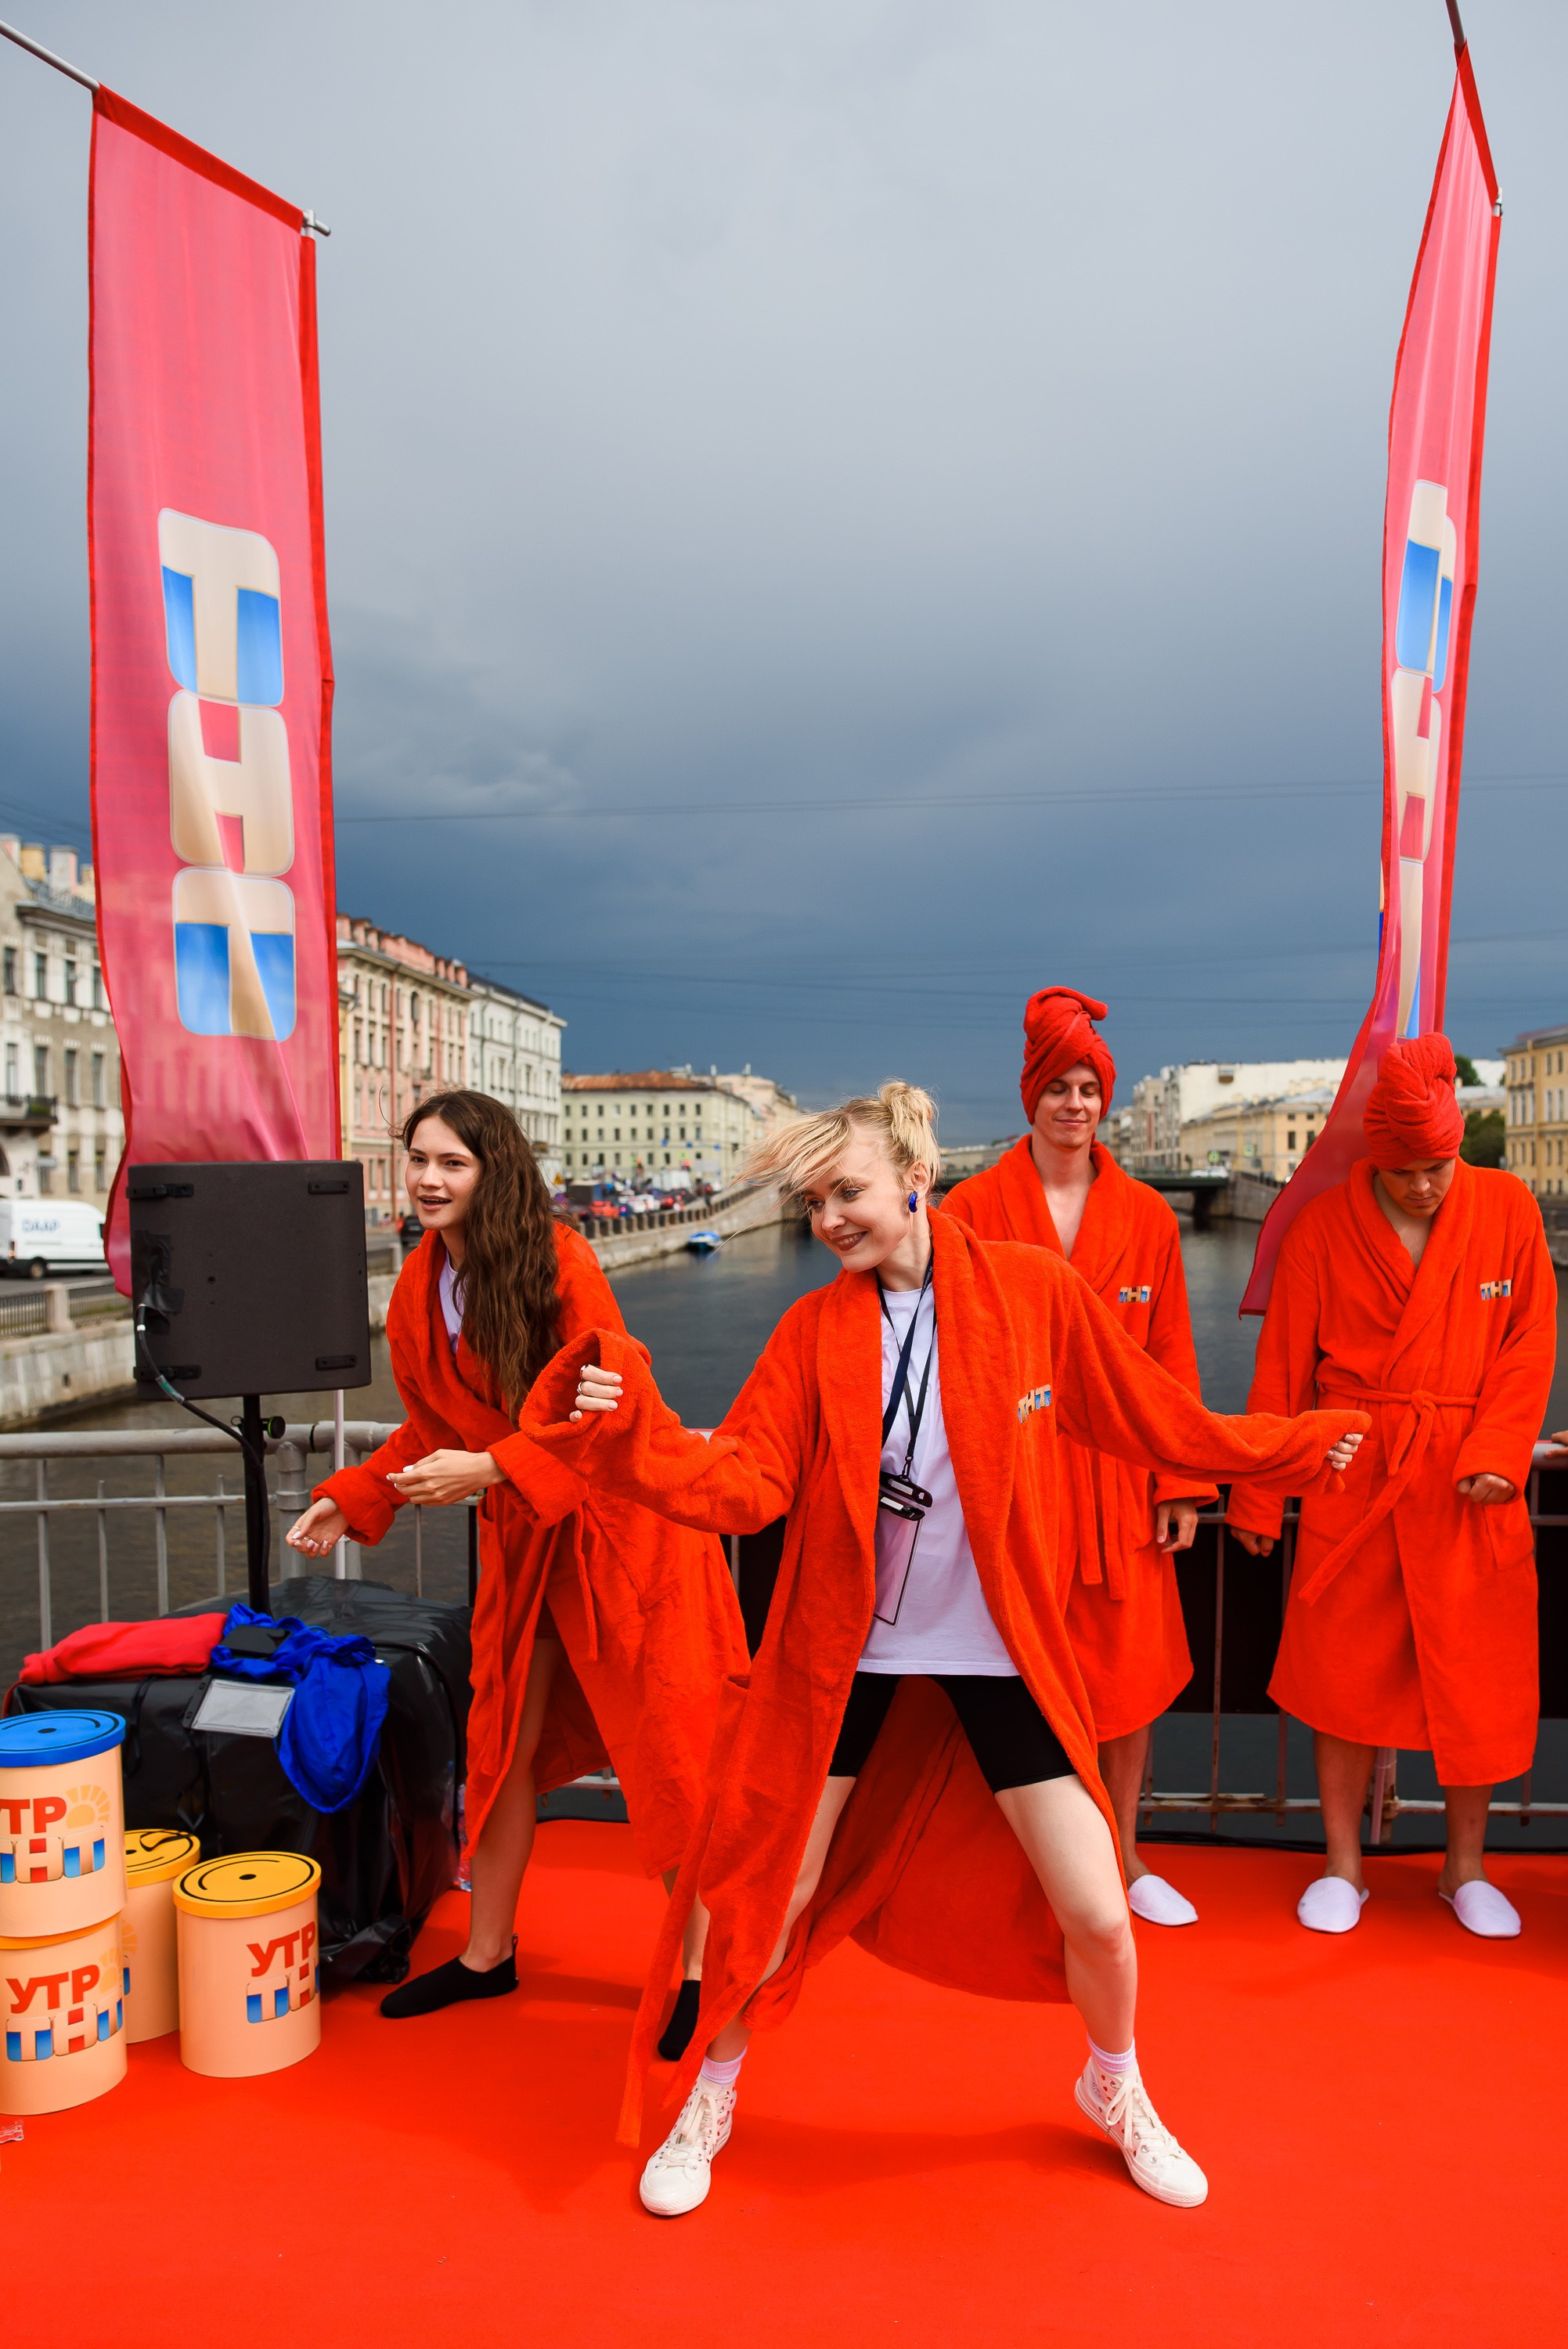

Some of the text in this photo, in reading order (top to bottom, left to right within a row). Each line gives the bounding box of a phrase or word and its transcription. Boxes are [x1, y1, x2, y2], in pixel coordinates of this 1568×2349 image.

[158, 507, 297, 1042] ТНТ
[1119, 1286, 1152, 1303] ТНТ
[1018, 1384, 1051, 1423] ТНТ
[247, 1958, 319, 2024] ТН
[5, 1995, 123, 2062] ТНТ
